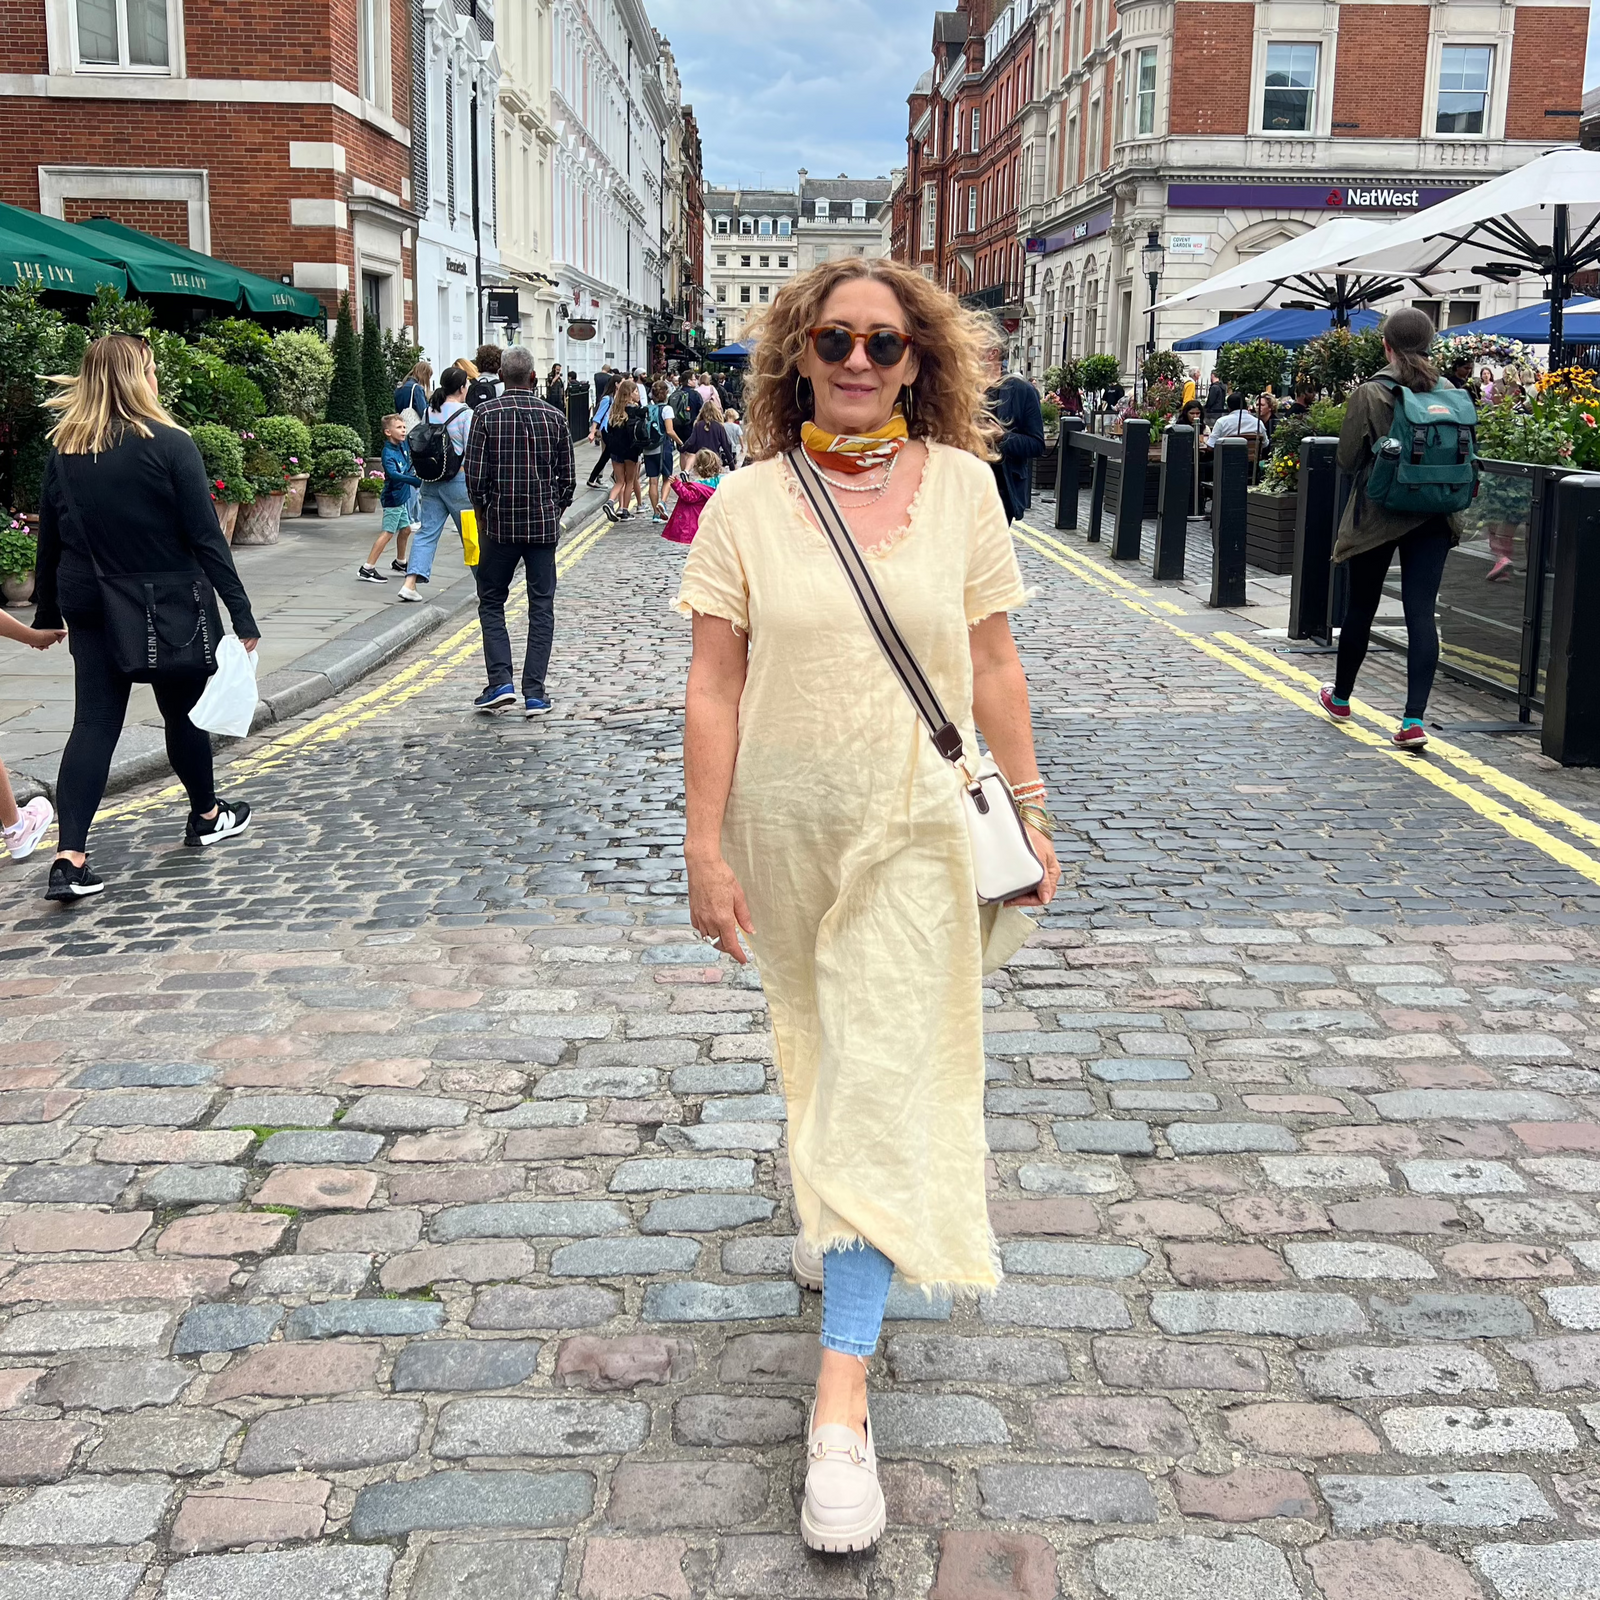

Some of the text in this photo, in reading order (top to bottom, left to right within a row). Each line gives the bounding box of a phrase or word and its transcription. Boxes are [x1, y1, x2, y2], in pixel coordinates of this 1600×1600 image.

[1346, 188, 1419, 206] NatWest
[12, 261, 74, 283] THE IVY
[170, 273, 206, 289] THE IVY
[147, 636, 157, 664] KLEIN
[203, 644, 213, 664] KLEI
